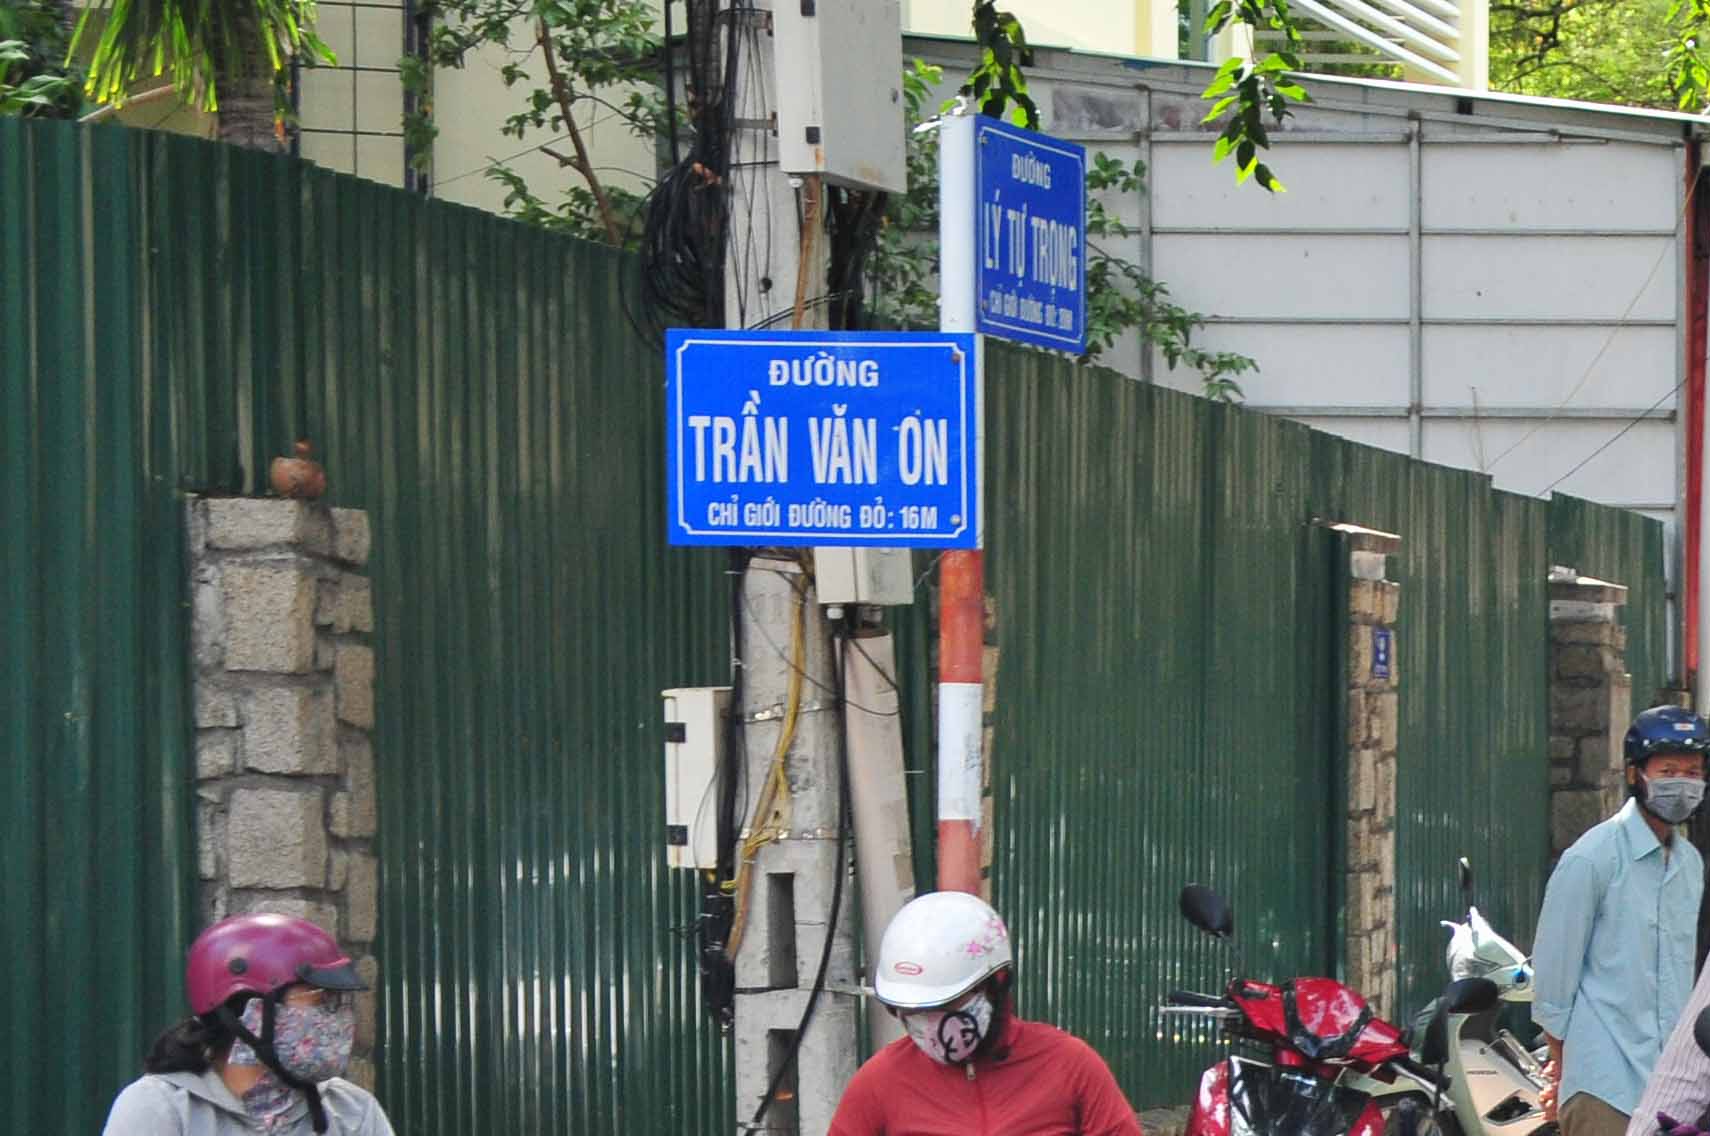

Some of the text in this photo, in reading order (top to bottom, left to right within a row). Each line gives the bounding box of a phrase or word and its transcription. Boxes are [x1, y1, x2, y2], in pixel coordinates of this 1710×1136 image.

[984, 188, 1002, 270] LÝ
[1030, 215, 1077, 296] TRỌNG
[768, 351, 880, 387] ĐƯỜNG
[688, 389, 789, 484] TRẦN
[808, 402, 879, 485] VĂN
[707, 494, 938, 530] CHỈ GIỚI ĐƯỜNG ĐỎ: 16M
